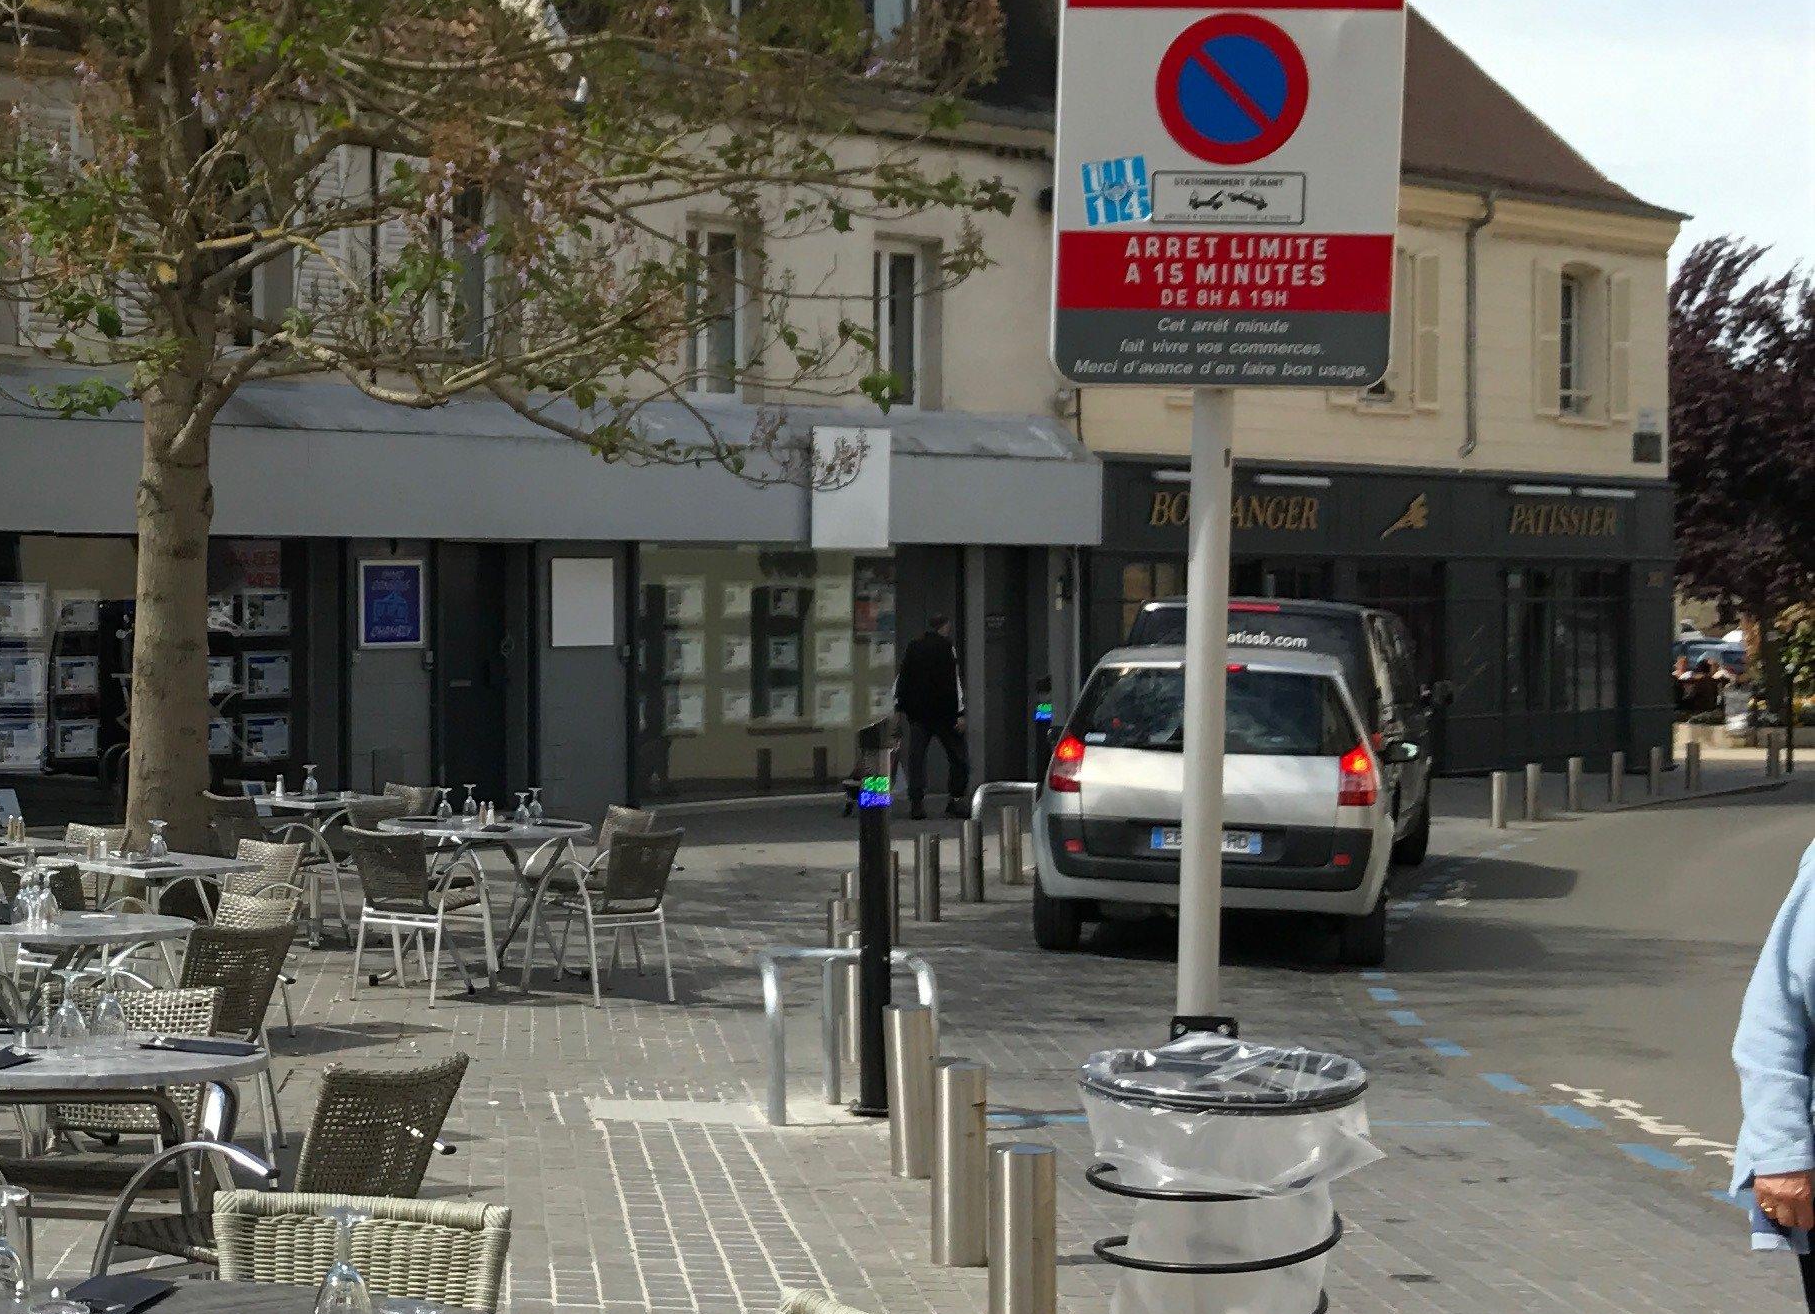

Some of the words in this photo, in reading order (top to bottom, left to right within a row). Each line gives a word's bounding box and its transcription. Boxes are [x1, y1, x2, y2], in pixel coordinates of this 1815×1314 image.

[1124, 236, 1219, 259] ARRET
[1230, 237, 1329, 260] LIMITE
[1124, 262, 1141, 285] A
[1153, 262, 1185, 285] 15
[1196, 262, 1327, 286] MINUTES
[1160, 288, 1188, 306] DE
[1196, 289, 1222, 306] 8H
[1228, 289, 1241, 307] A
[1249, 290, 1289, 307] 19H
[1157, 317, 1186, 333] Cet
[1234, 319, 1289, 334] minute
[1119, 338, 1145, 353] fait
[1152, 339, 1190, 354] vivre
[1196, 342, 1223, 354] vos
[1073, 359, 1118, 374] Merci
[1123, 360, 1193, 375] d'avance
[1199, 361, 1236, 376] d'en
[1239, 362, 1276, 376] faire
[1281, 363, 1313, 377] bon
[1149, 491, 1320, 532] BOANGER
[1227, 630, 1308, 648] atissb.com
